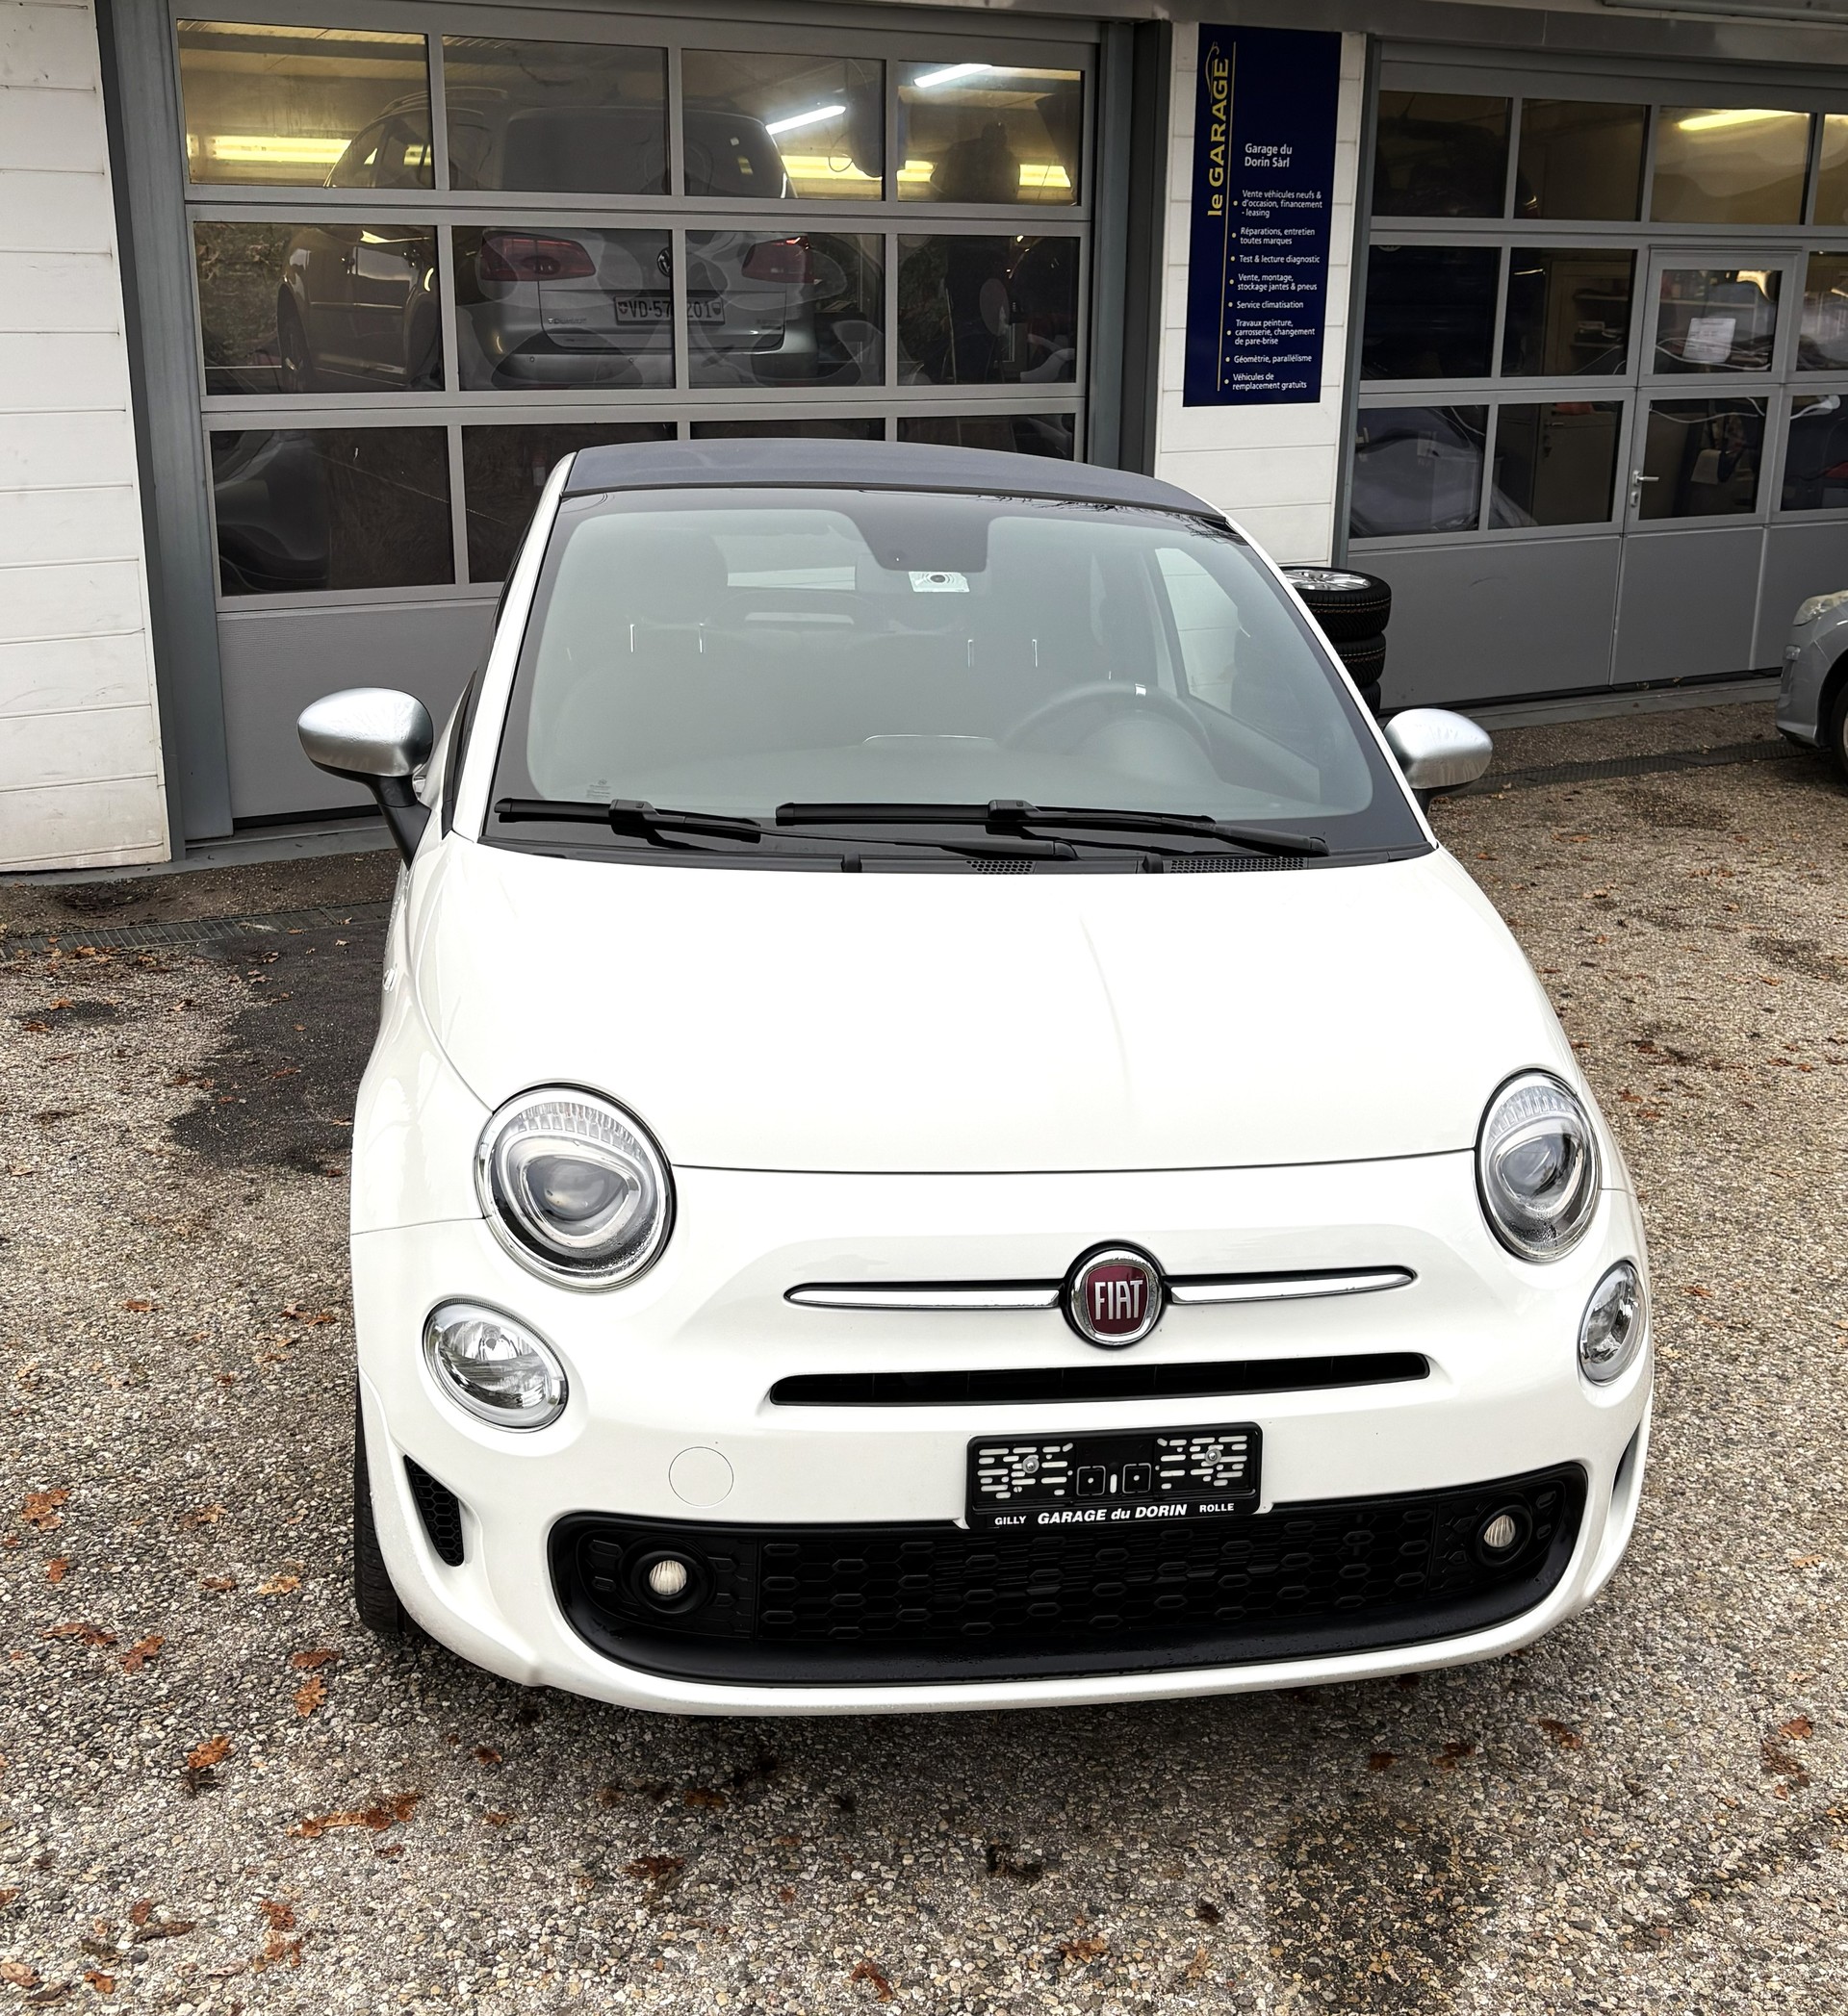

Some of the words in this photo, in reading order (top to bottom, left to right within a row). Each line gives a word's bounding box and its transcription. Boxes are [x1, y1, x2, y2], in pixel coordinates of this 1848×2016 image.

[1209, 58, 1229, 187] GARAGE
[1245, 143, 1278, 156] Garage
[1280, 143, 1293, 154] du
[1245, 156, 1270, 166] Dorin
[1264, 190, 1295, 198] véhicules
[1208, 194, 1222, 217] le
[1280, 199, 1322, 208] financement
[1245, 208, 1270, 218] leasing
[1241, 226, 1283, 237] Réparations,
[1284, 227, 1316, 236] entretien
[1263, 238, 1293, 246] marques
[1286, 255, 1321, 266] diagnostic
[1238, 273, 1261, 282] Vente,
[1261, 274, 1294, 283] montage,
[1237, 282, 1268, 292] stockage
[1268, 282, 1289, 292] jantes
[1237, 300, 1261, 309] Service
[1261, 300, 1304, 309] climatisation
[1236, 319, 1262, 327] Travaux
[1263, 319, 1294, 328] peinture,
[1235, 328, 1272, 337] carrosserie,
[1273, 327, 1316, 338] changement
[1234, 337, 1244, 345] de
[1245, 337, 1279, 346] pare-brise
[1272, 354, 1312, 364] parallélisme
[1233, 372, 1265, 381] Véhicules
[1232, 382, 1281, 392] remplacement
[1281, 380, 1307, 391] gratuits
[1094, 1279, 1143, 1320] FIAT
[994, 1516, 1027, 1527] GILLY
[1038, 1508, 1107, 1525] GARAGE
[1111, 1507, 1132, 1520] du
[1135, 1504, 1188, 1518] DORIN
[1199, 1503, 1235, 1513] ROLLE
